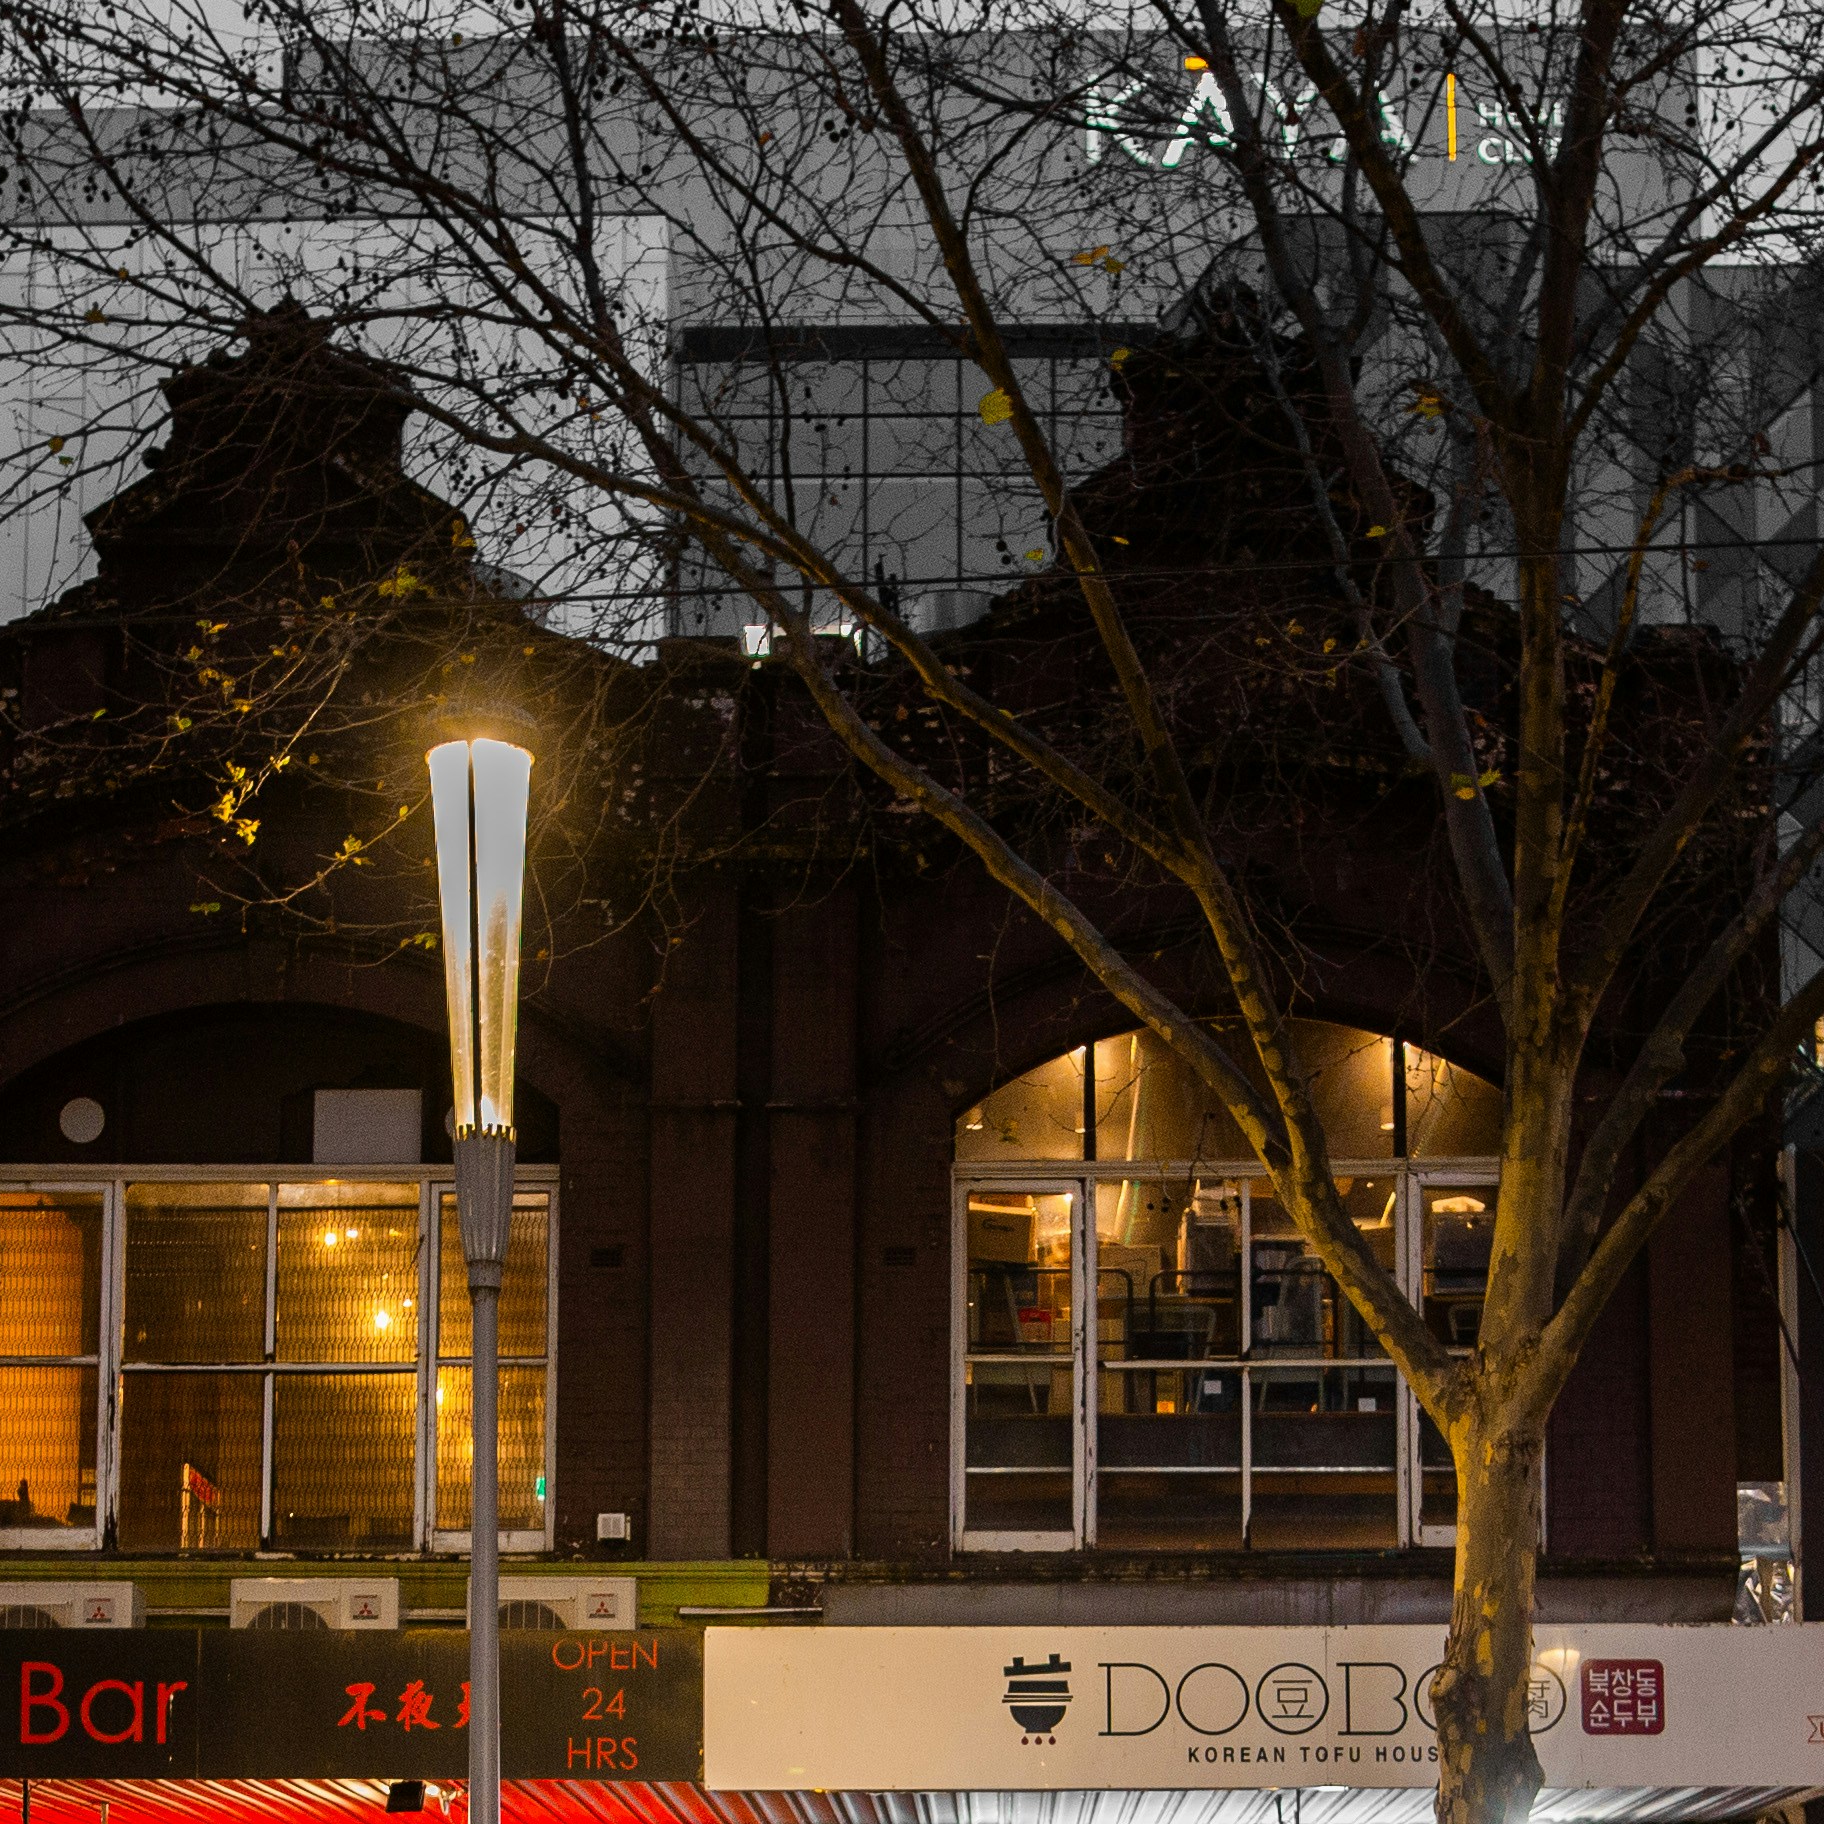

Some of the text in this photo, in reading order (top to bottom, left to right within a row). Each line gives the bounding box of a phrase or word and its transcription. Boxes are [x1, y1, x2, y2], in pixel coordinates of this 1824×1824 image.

[552, 1639, 658, 1670] OPEN
[1588, 1668, 1657, 1698] 북창동
[21, 1661, 187, 1744] Bar
[581, 1687, 626, 1721] 24
[1589, 1699, 1657, 1728] 순두부
[567, 1737, 638, 1770] HRS
[1188, 1746, 1440, 1763] KOREAN TOFU HOUS
